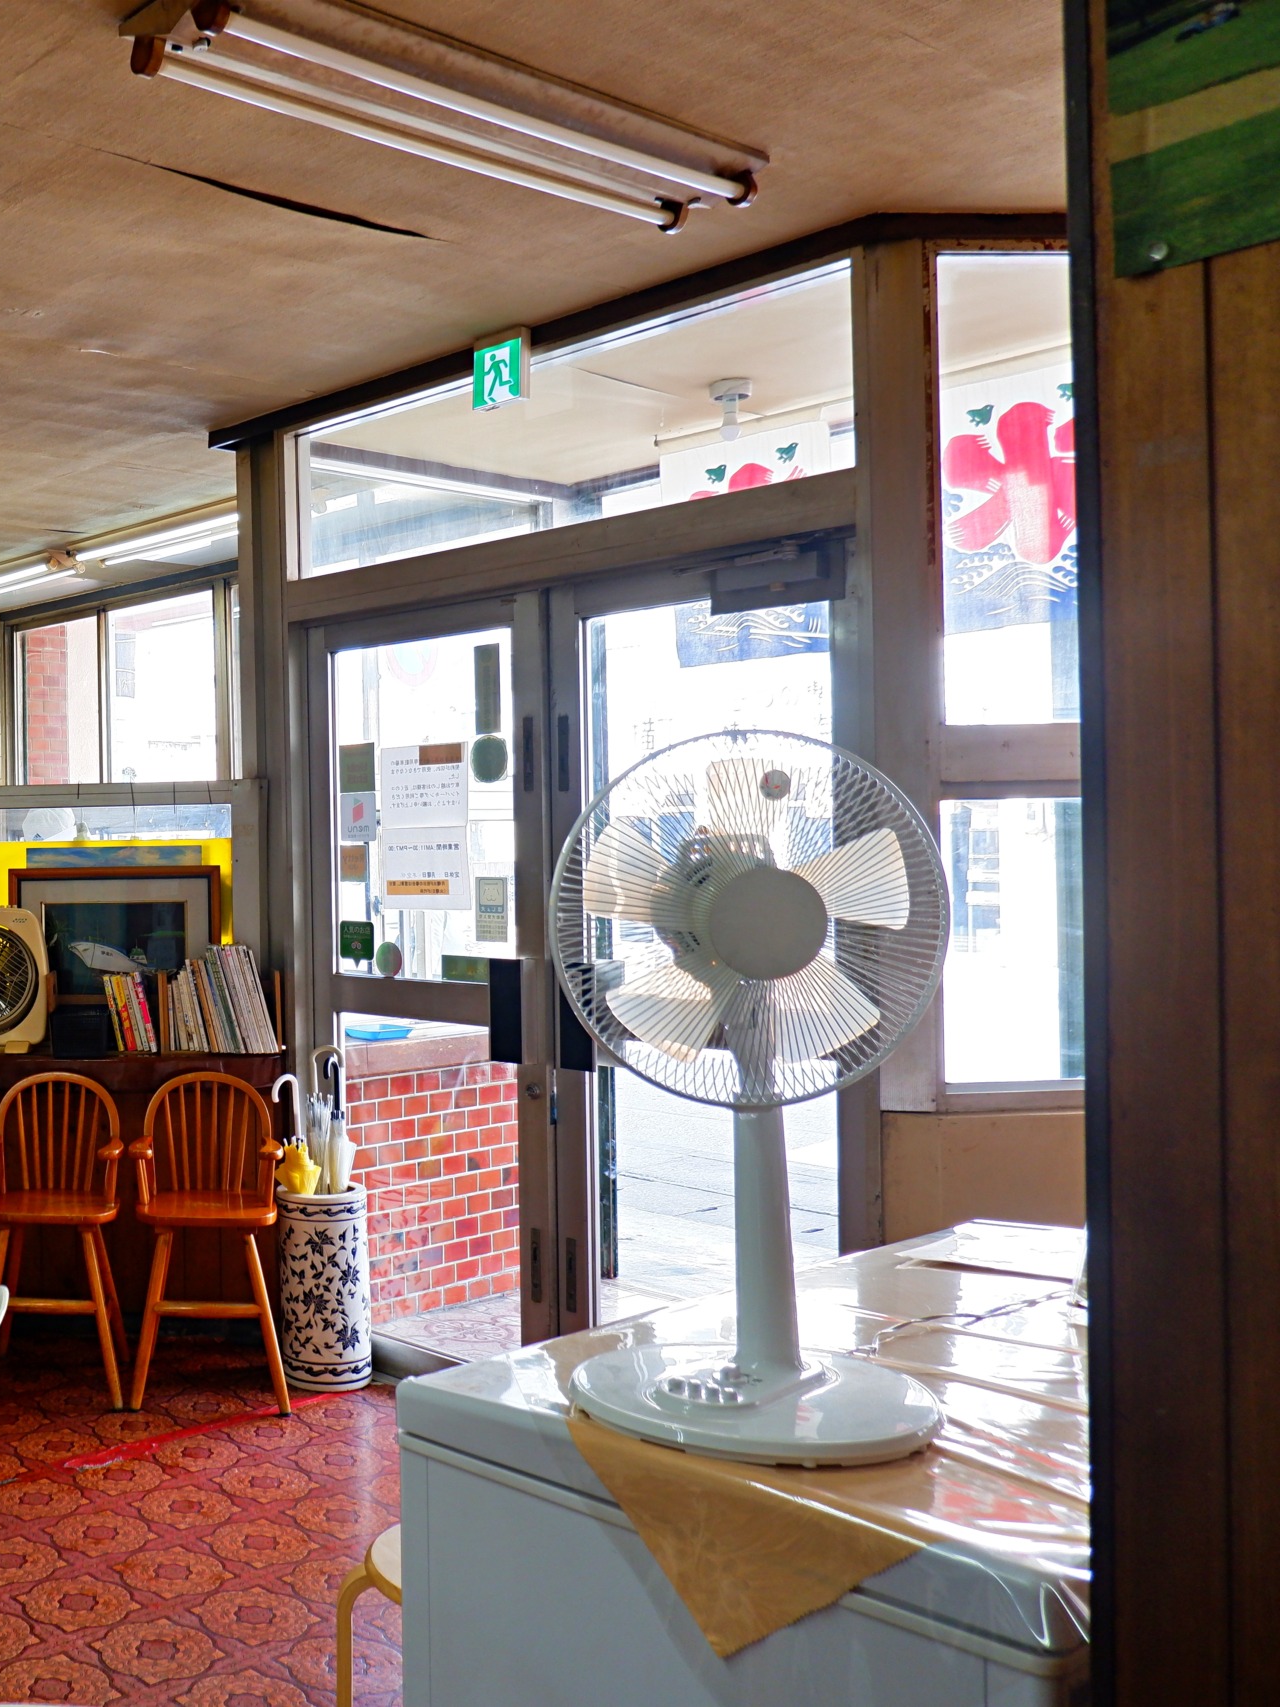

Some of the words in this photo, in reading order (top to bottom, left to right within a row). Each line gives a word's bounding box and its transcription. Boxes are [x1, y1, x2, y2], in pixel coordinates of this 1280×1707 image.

[343, 925, 371, 934] 人気のお店
